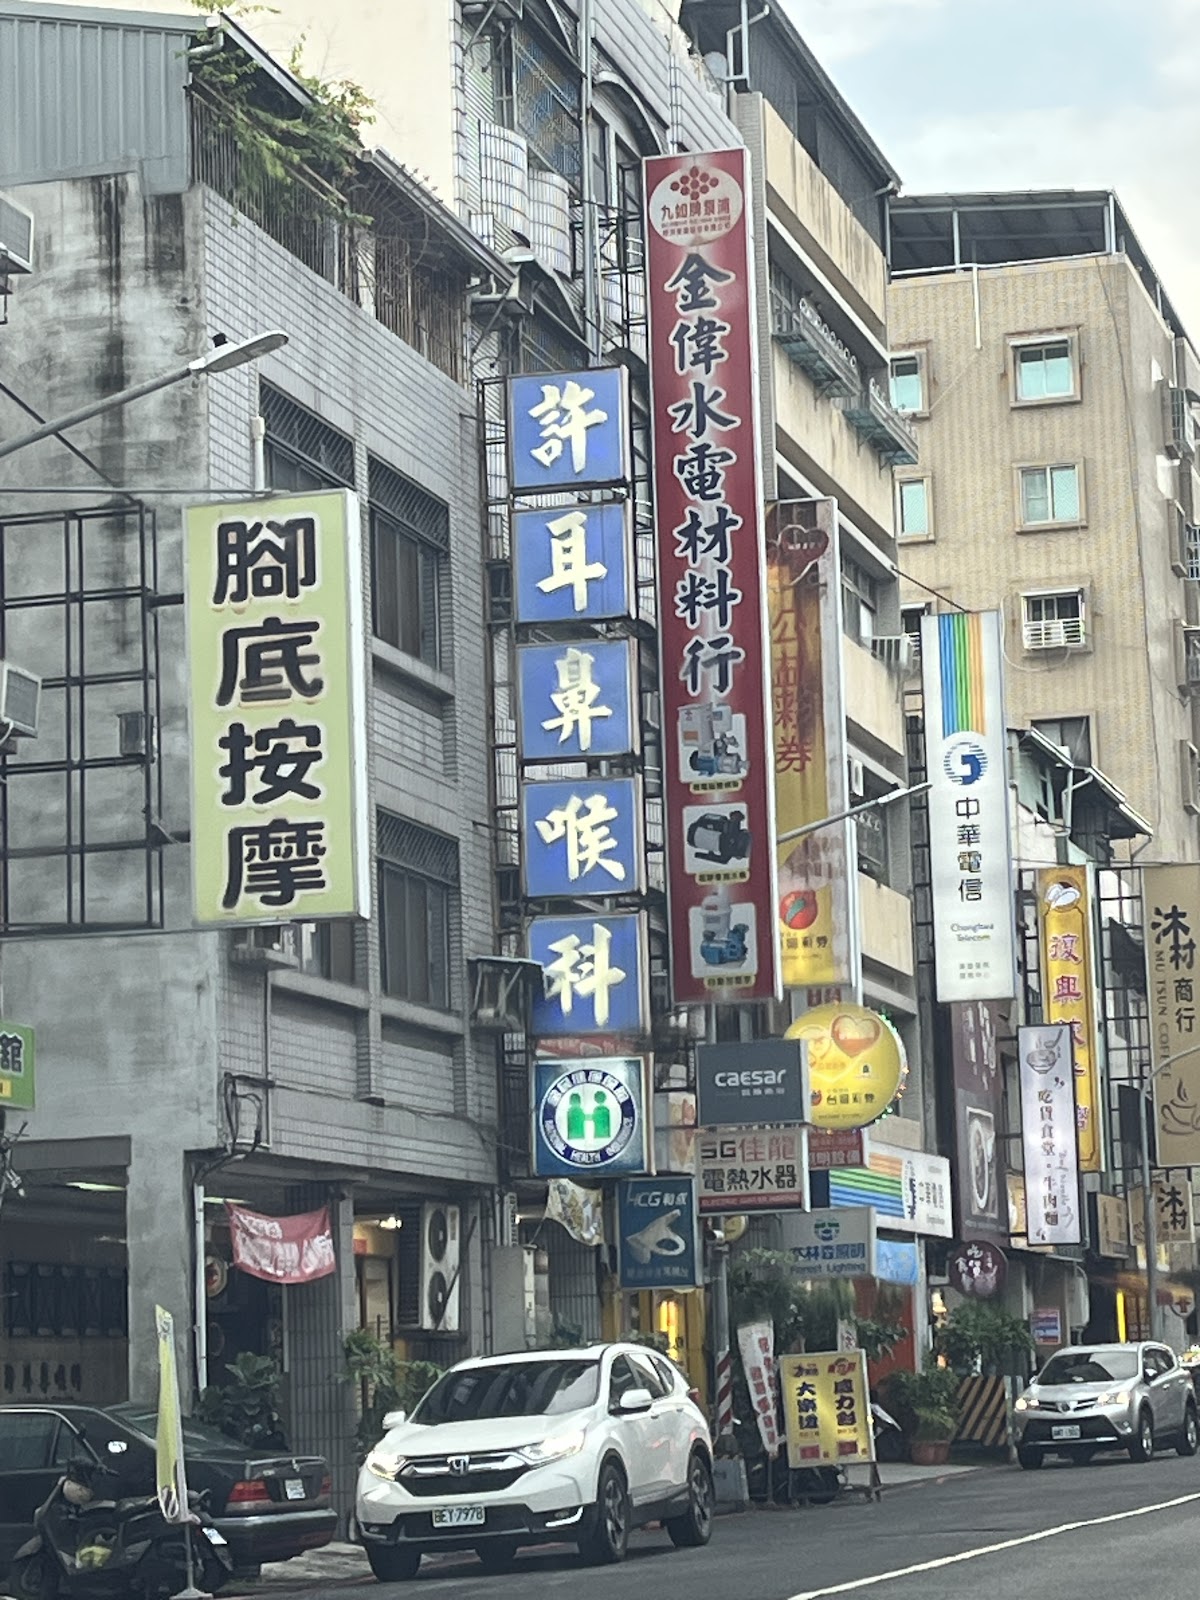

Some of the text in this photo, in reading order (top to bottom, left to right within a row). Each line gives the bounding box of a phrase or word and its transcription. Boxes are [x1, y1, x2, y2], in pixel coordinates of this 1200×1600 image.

[664, 253, 744, 694] 金偉水電材料行
[211, 516, 328, 909] 腳底按摩
[527, 380, 626, 1027] 許耳鼻喉科
[954, 796, 983, 903] 中華電信
[1151, 904, 1196, 1034] 沐村商行
[1154, 951, 1165, 973] MU
[1156, 980, 1168, 1016] TSUN
[714, 1069, 786, 1087] caesar
[702, 1164, 797, 1192] 電熱水器
[1158, 1186, 1188, 1230] 沐村
